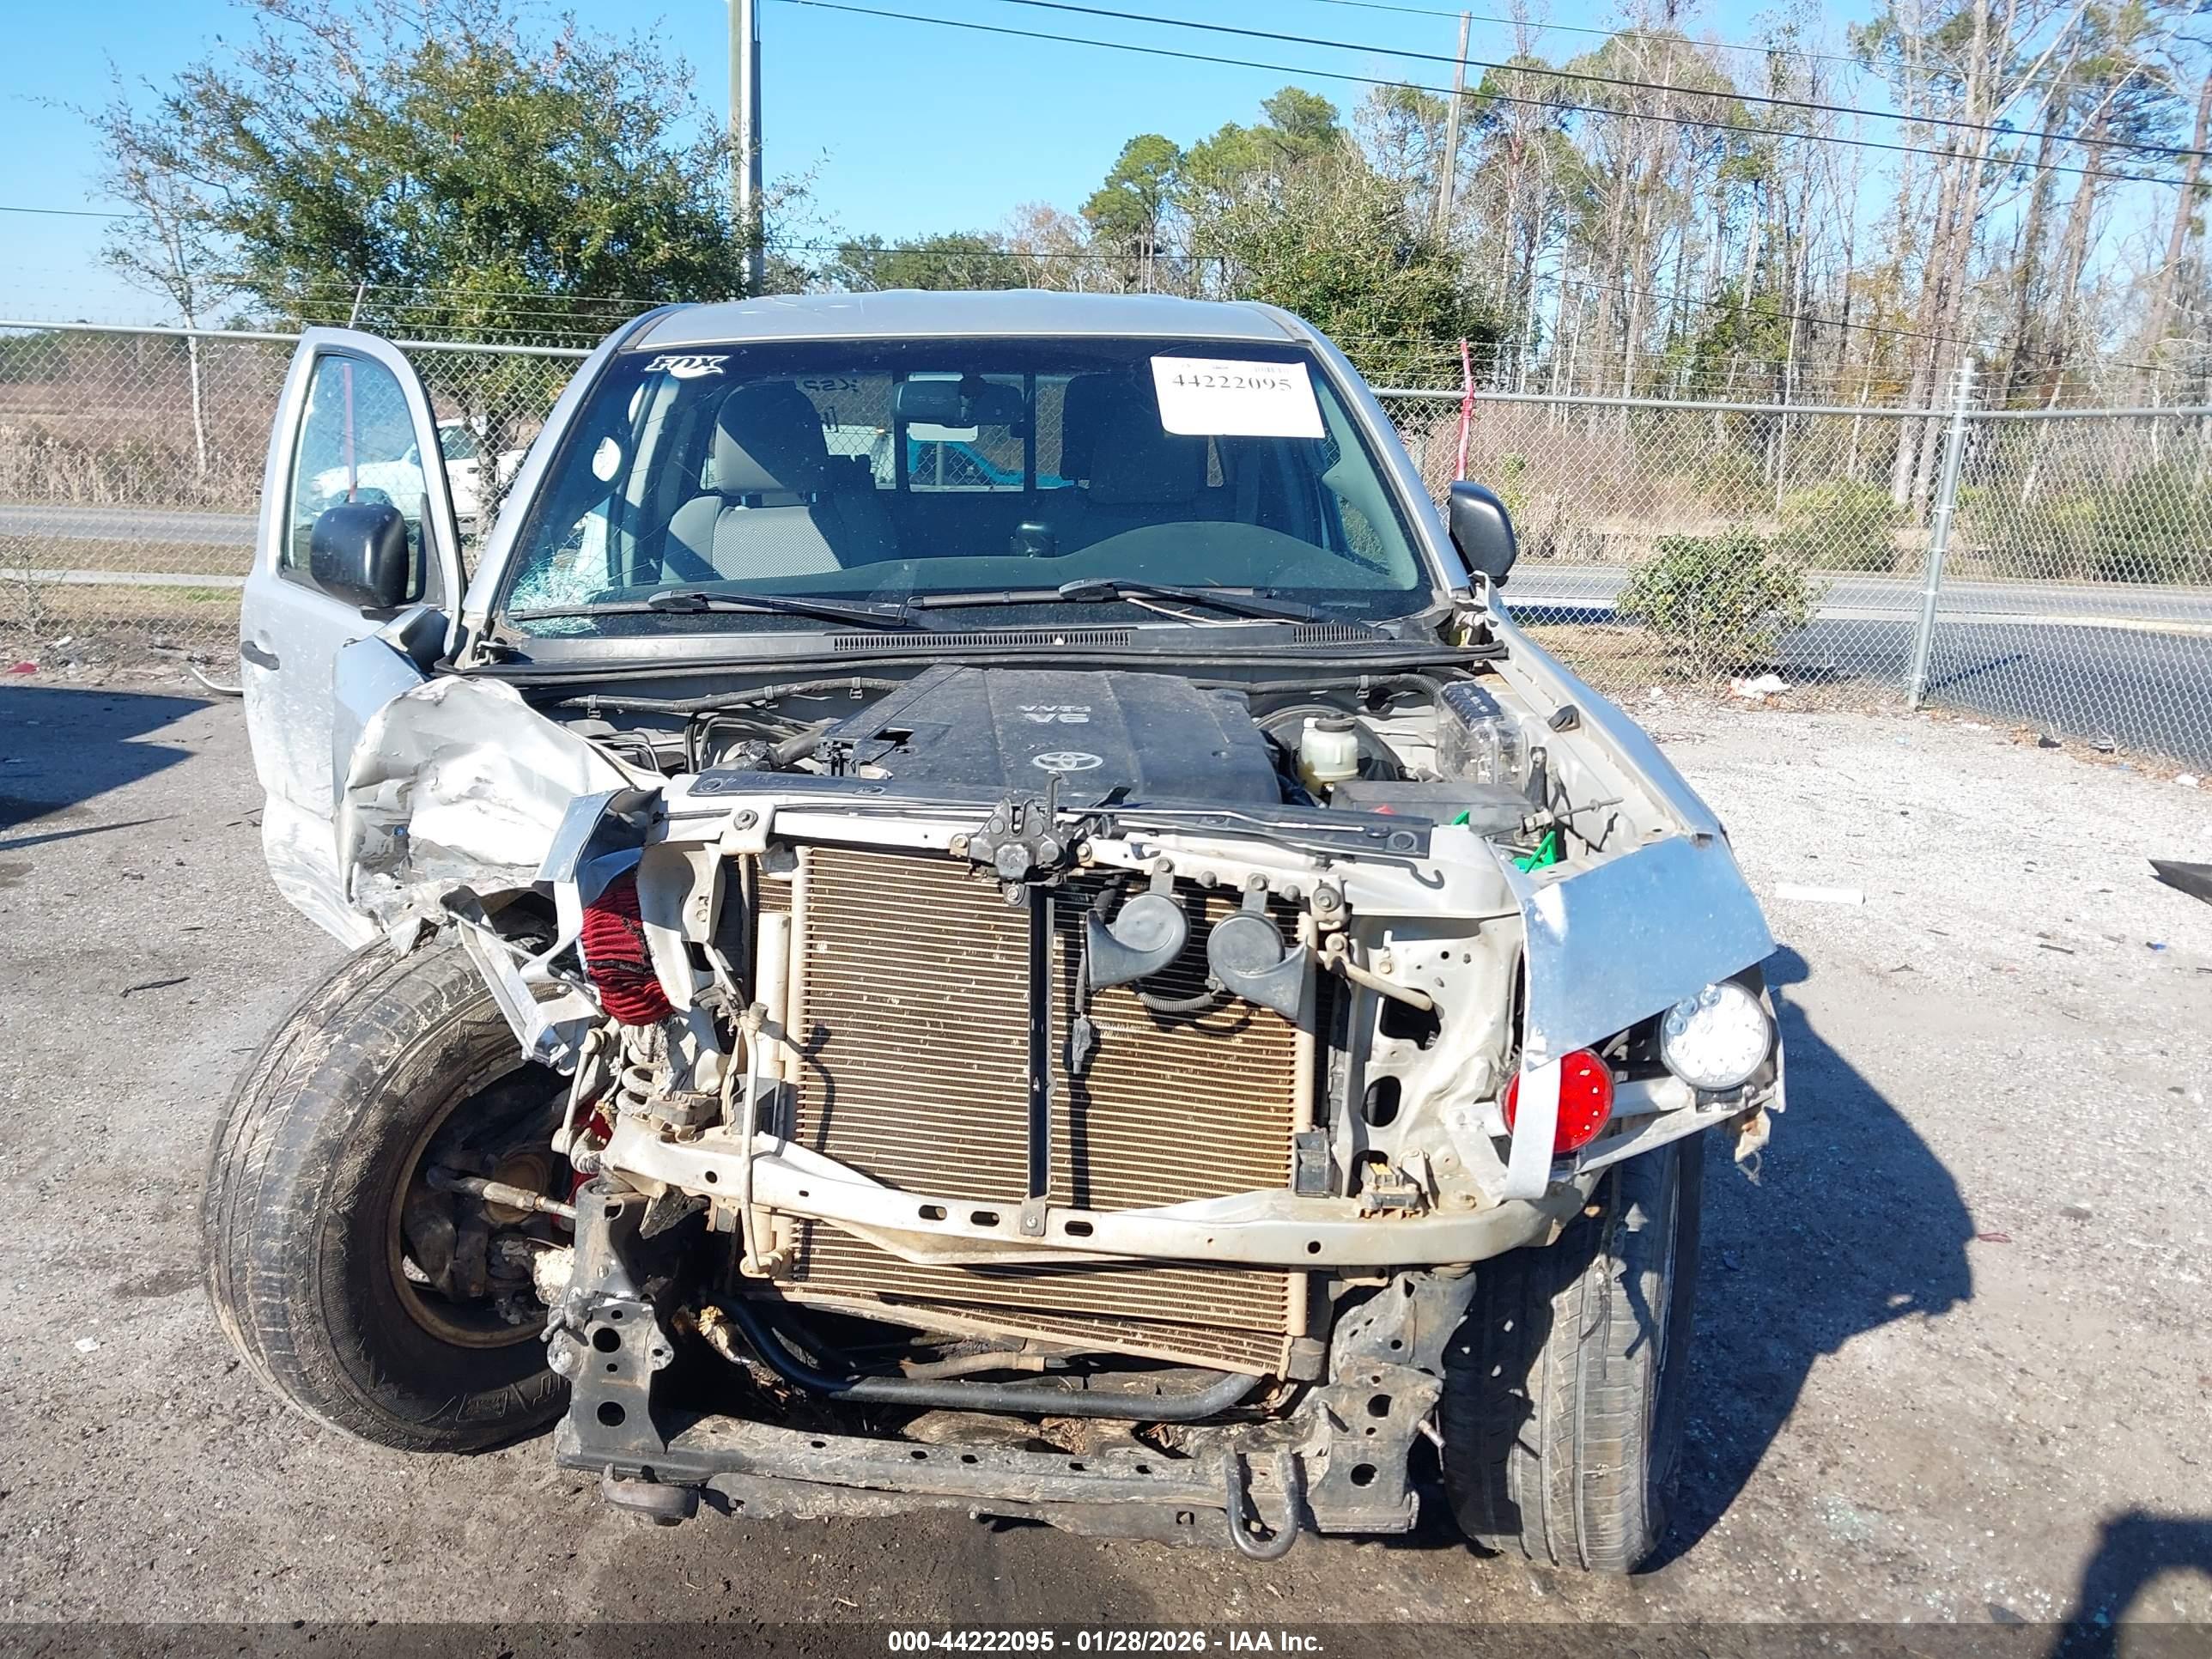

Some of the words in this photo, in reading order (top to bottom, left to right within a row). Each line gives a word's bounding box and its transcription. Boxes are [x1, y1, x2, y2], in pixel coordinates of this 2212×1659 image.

[641, 355, 731, 379] FOX
[1172, 373, 1293, 392] 44222095
[1024, 713, 1091, 724] V6
